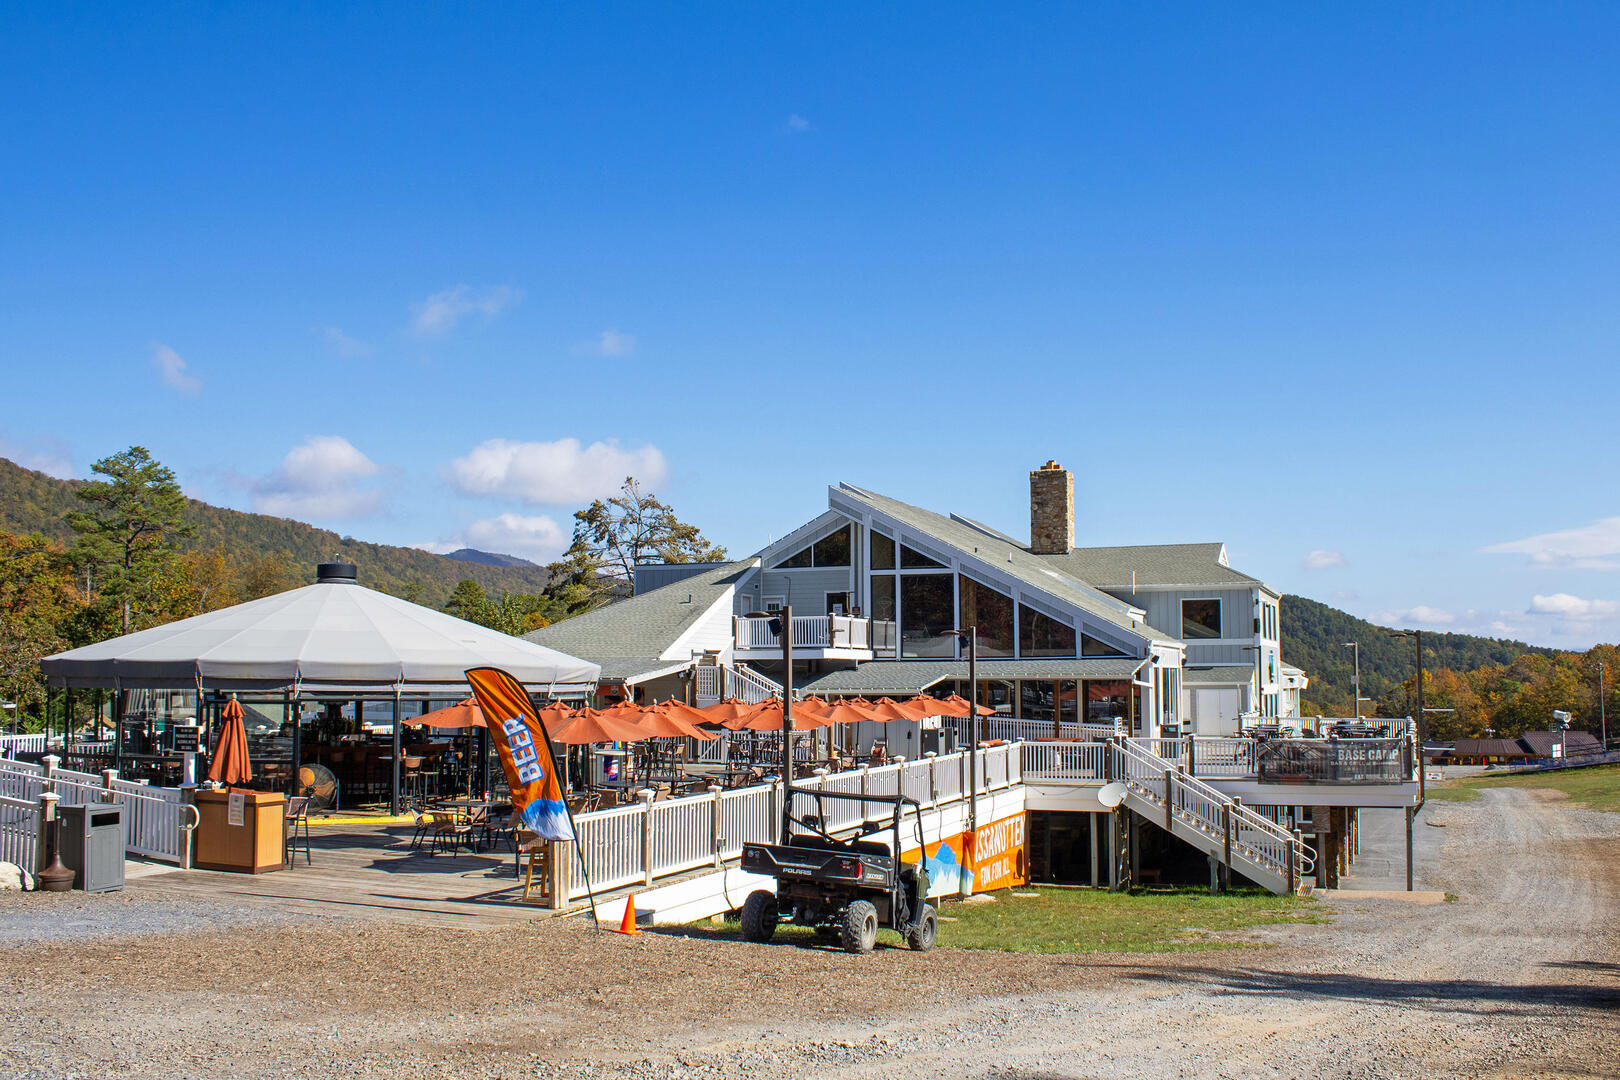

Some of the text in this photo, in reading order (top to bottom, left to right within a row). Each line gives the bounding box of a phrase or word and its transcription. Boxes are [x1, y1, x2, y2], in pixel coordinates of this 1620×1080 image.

[502, 713, 544, 786] BEER
[1338, 749, 1365, 760] BASE
[782, 867, 812, 876] POLARIS
[980, 864, 991, 888] FUN
[992, 859, 1002, 881] FOR
